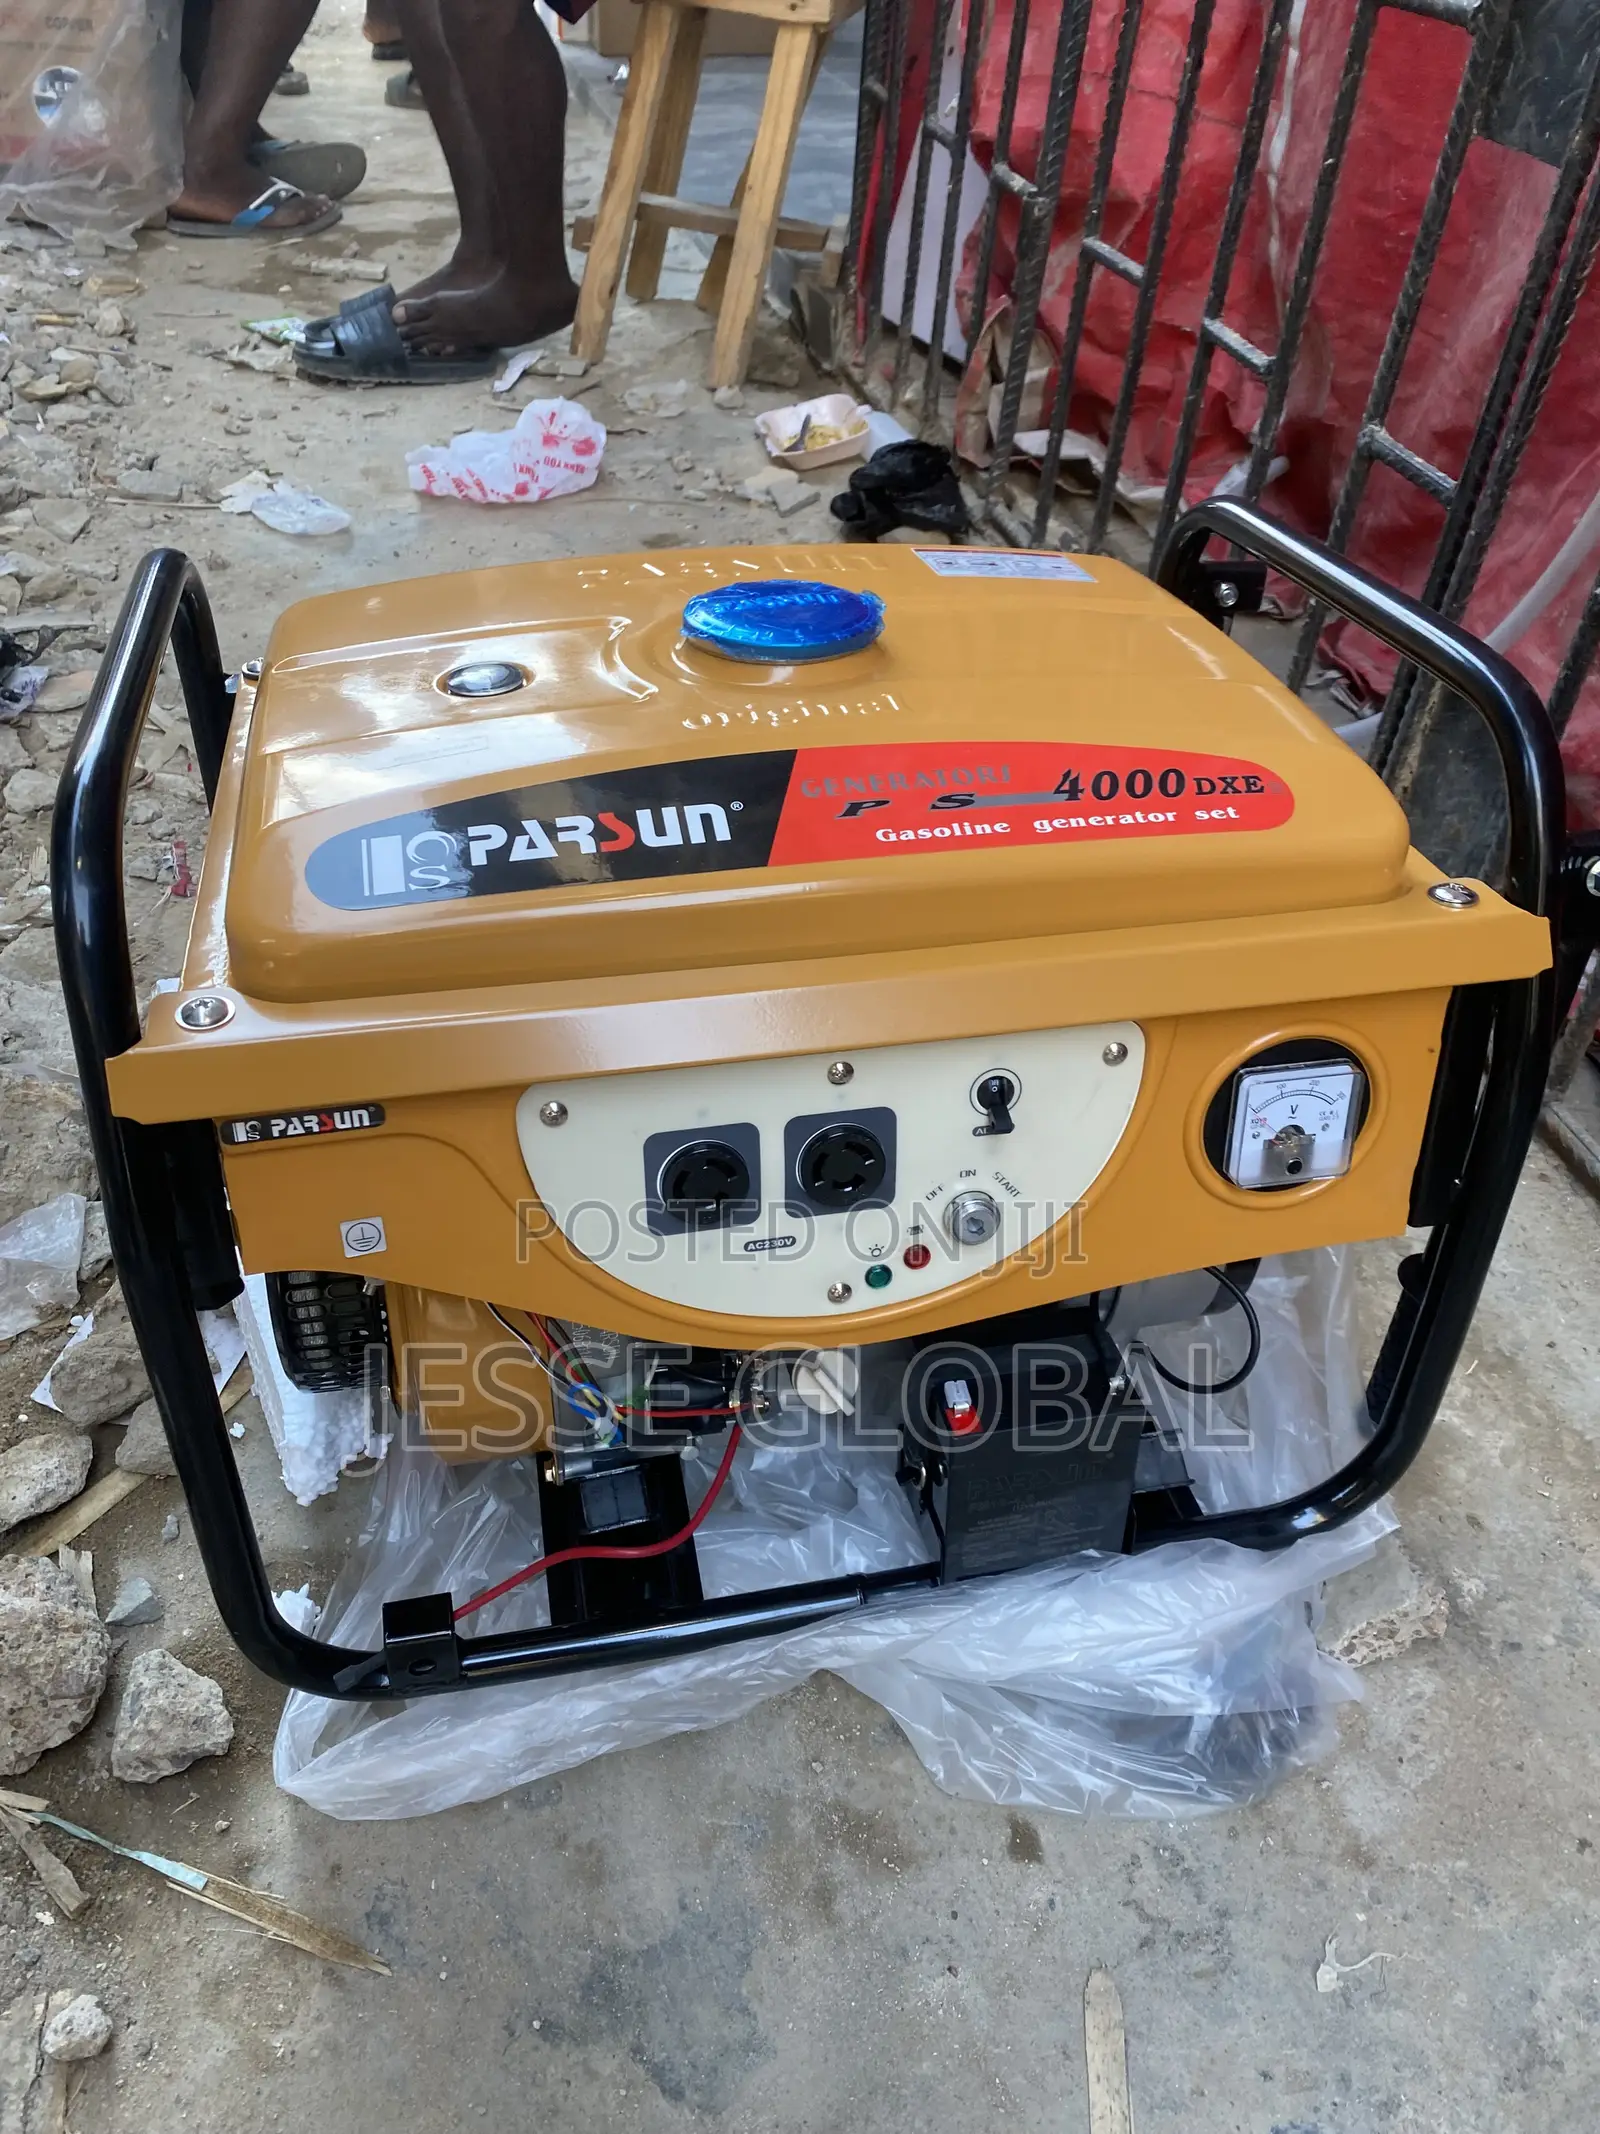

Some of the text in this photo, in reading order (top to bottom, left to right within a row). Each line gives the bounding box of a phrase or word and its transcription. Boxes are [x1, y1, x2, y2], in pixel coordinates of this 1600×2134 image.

[835, 799, 890, 818] P
[929, 793, 976, 811] S
[875, 806, 1240, 843] Gasoline generator set
[1290, 1104, 1299, 1115] V
[959, 1169, 977, 1179] ON
[925, 1183, 945, 1202] OFF
[992, 1171, 1022, 1199] START
[746, 1237, 793, 1252] AC230V
